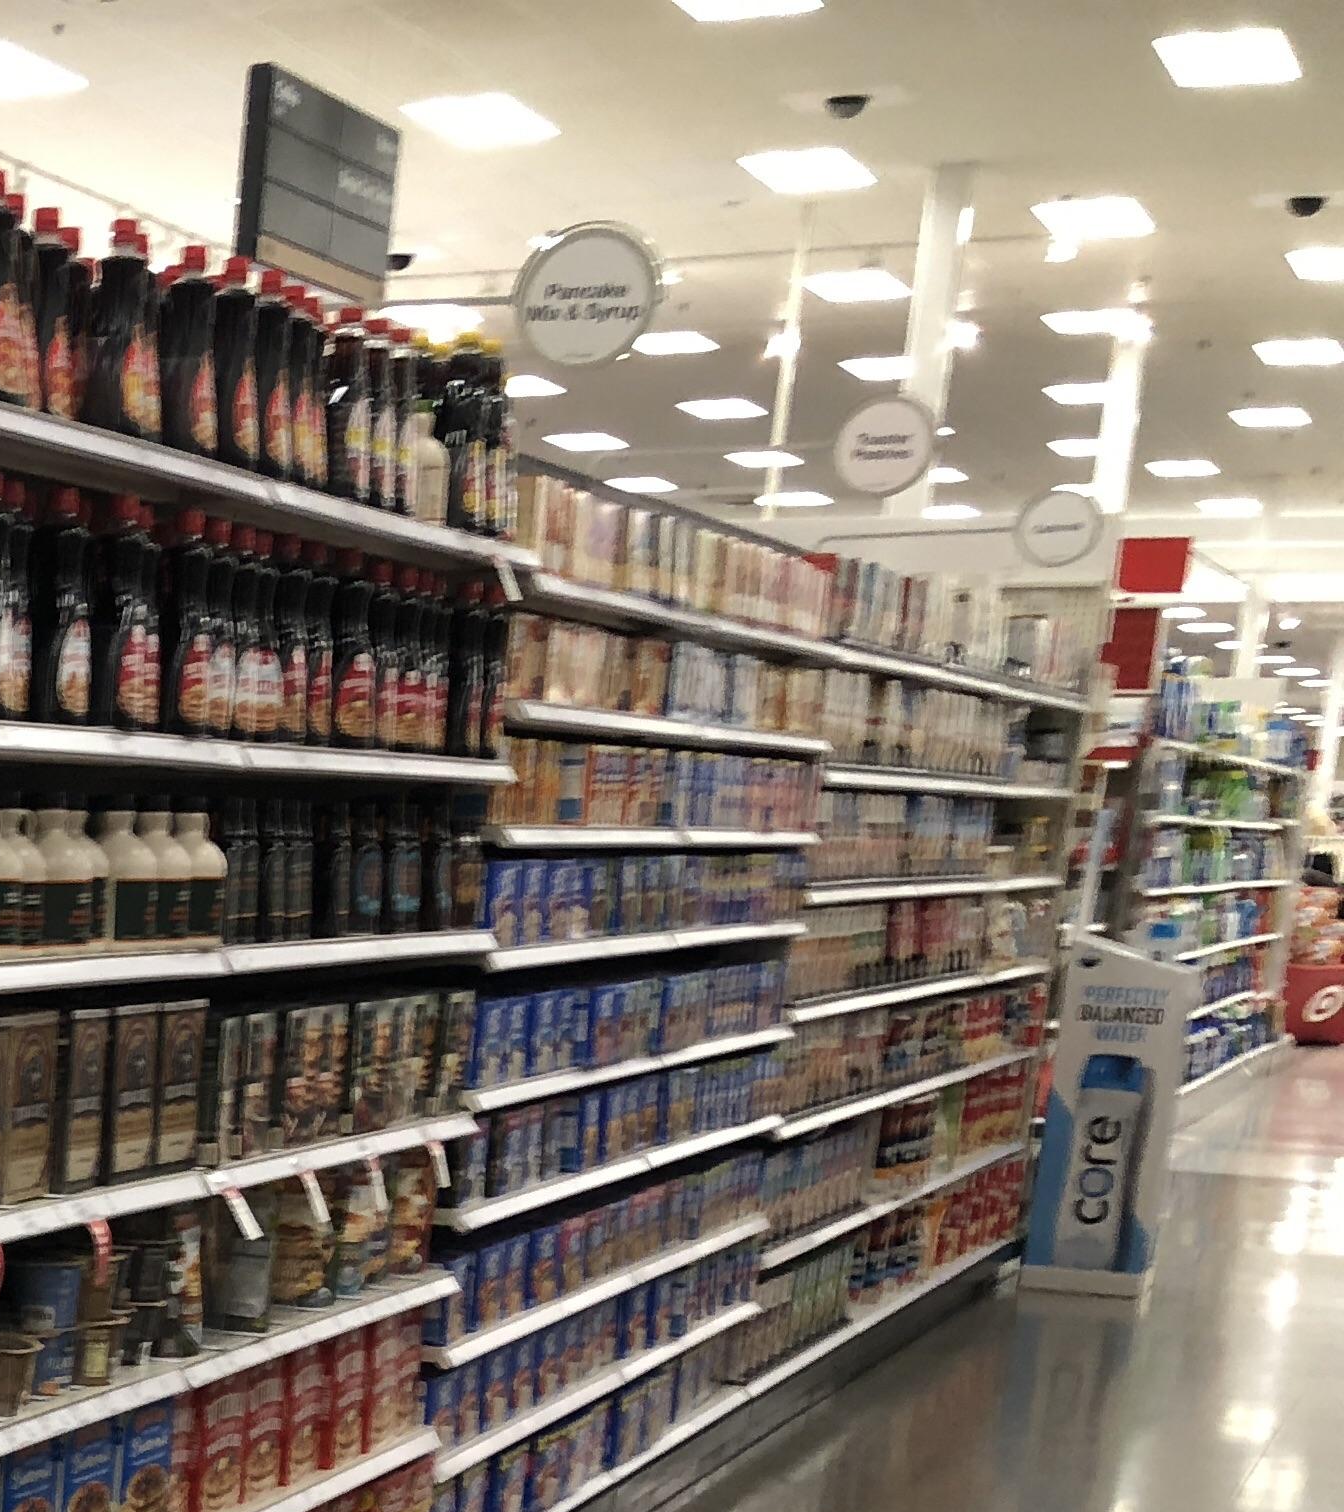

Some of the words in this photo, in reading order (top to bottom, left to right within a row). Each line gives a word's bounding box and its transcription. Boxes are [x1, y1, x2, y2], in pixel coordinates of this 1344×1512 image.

[1083, 984, 1168, 1006] PERFECTLY
[1079, 1004, 1165, 1025] BALANCED
[1094, 1024, 1147, 1043] WATER
[1073, 1115, 1122, 1225] core
